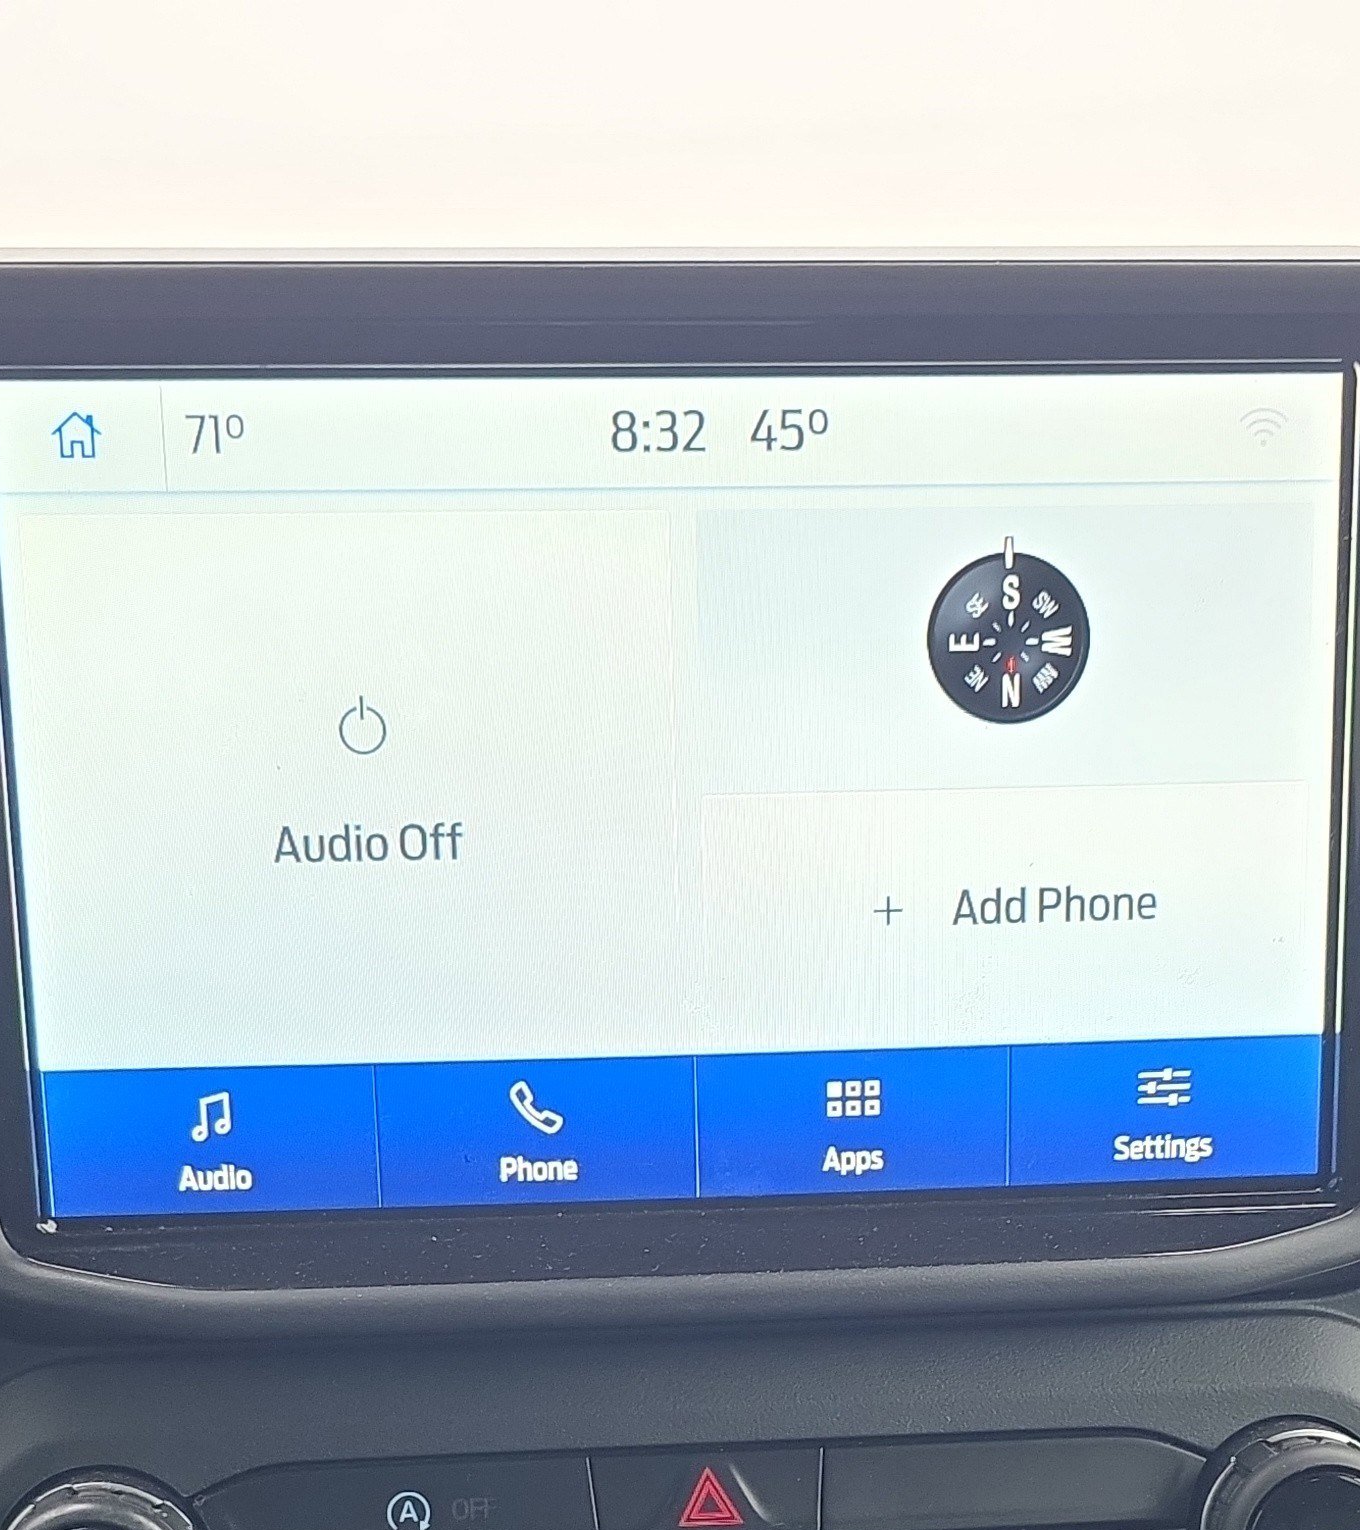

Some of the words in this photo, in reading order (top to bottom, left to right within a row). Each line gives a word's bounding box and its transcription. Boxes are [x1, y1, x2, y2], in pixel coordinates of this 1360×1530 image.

[185, 413, 244, 454] 71°
[611, 409, 706, 452] 8:32
[750, 408, 829, 452] 45°
[965, 592, 989, 619] SE
[1002, 574, 1021, 611] S
[1032, 591, 1059, 619] SW
[948, 632, 980, 653] E
[1041, 625, 1073, 657] W
[963, 664, 989, 693] NE
[1001, 673, 1021, 708] N
[274, 823, 389, 863] Audio
[399, 821, 464, 861] Off
[952, 886, 1027, 926] Add
[1039, 884, 1158, 923] Phone
[822, 1146, 885, 1176] Apps
[1113, 1134, 1214, 1163] Settings
[179, 1163, 254, 1192] Audio
[499, 1156, 579, 1183] Phone
